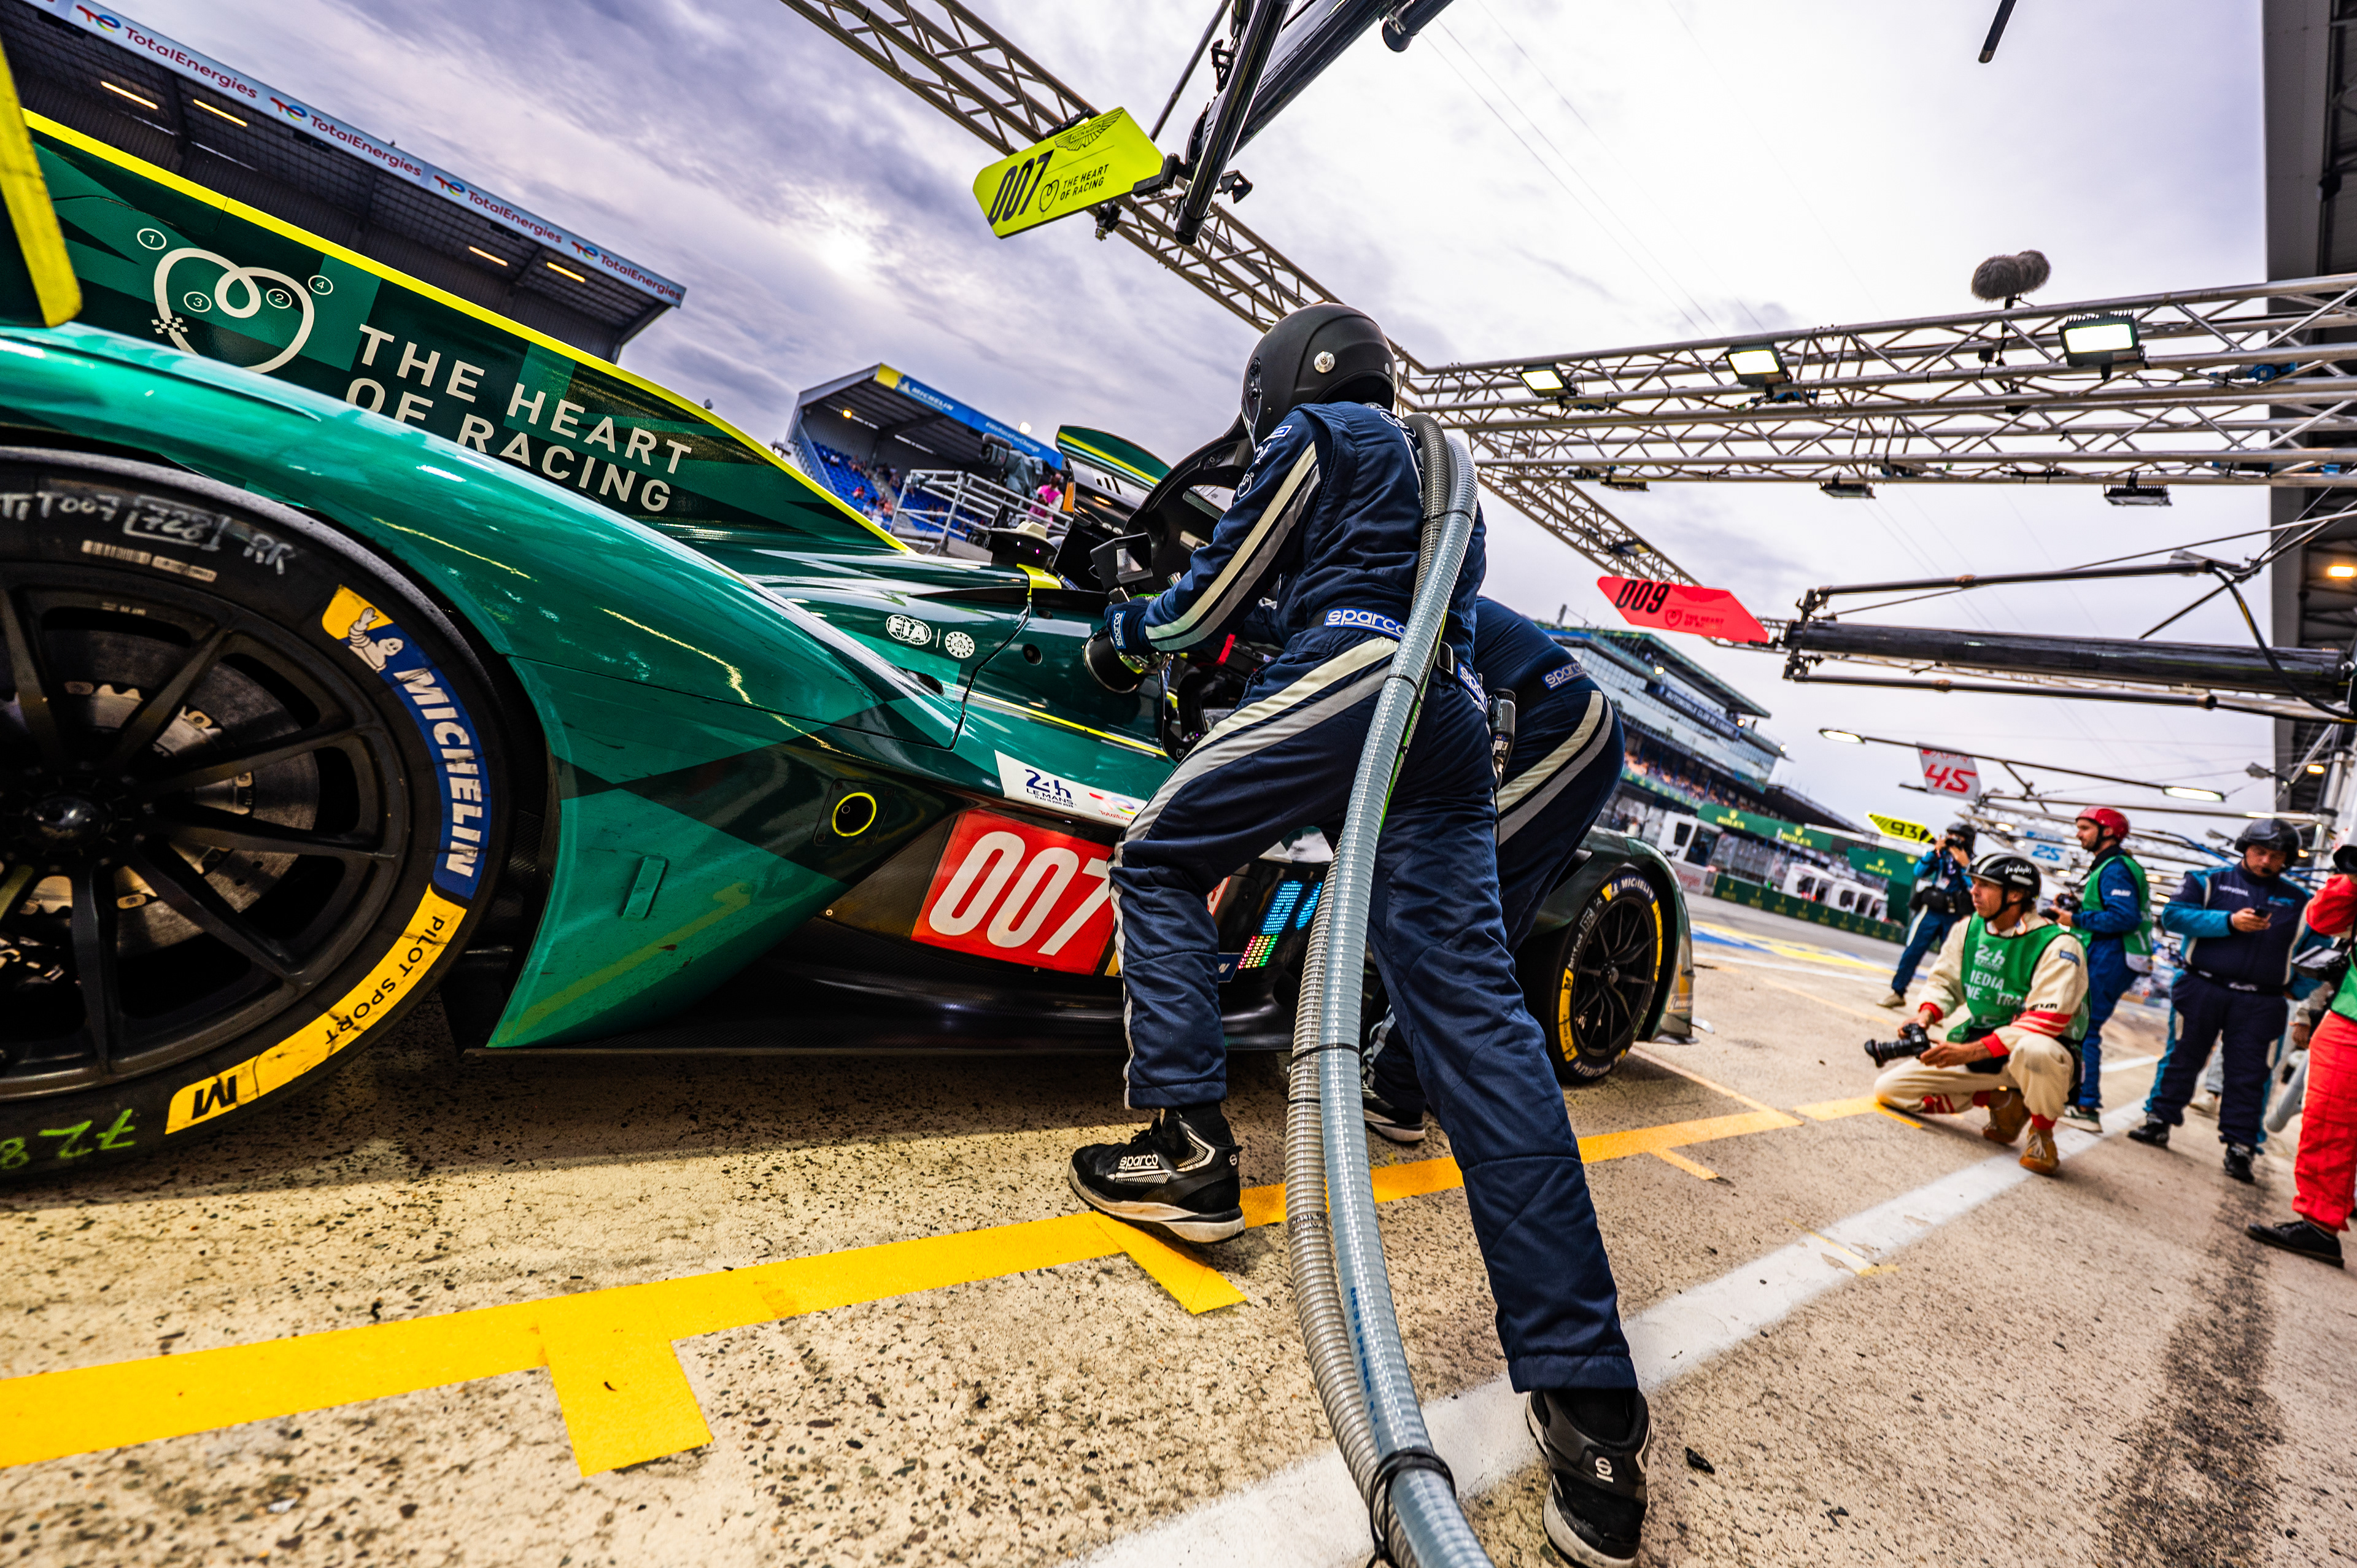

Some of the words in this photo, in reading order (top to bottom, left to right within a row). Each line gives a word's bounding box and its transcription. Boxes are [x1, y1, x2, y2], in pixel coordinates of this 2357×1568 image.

[124, 25, 258, 99] TotalEnergies
[309, 113, 422, 177] TotalEnergies
[1072, 130, 1085, 140] ASTON
[1085, 123, 1102, 134] MARTIN
[987, 149, 1055, 227] 007
[1059, 190, 1071, 201] OF
[1072, 177, 1105, 197] RACING
[1063, 176, 1079, 189] THE
[1080, 163, 1110, 184] HEART
[468, 189, 563, 244] TotalEnergies
[600, 253, 682, 302] TotalEnergies
[358, 323, 486, 404] THE
[506, 382, 692, 475] HEART
[911, 385, 954, 412] MICHELIN
[345, 377, 433, 423] OF
[456, 412, 672, 512] RACING
[1615, 579, 1671, 614] 009
[889, 616, 927, 642] FIA
[1113, 612, 1123, 647] sparco
[1327, 608, 1406, 636] sparco
[393, 668, 484, 878] MICHELIN
[1024, 768, 1072, 800] 24h
[1924, 763, 1978, 795] 45
[1026, 787, 1040, 797] LE
[1042, 792, 1074, 806] MANS
[1716, 815, 1746, 830] ROLEX
[1891, 822, 1918, 840] 93
[1781, 832, 1813, 848] ROLEX
[2031, 843, 2066, 862] 25
[1865, 863, 1893, 876] ROLEX
[928, 830, 1110, 957] 007
[1621, 877, 1654, 899] MICHELIN
[397, 914, 445, 979] PILOT
[325, 977, 397, 1045] SPORT
[1118, 1153, 1159, 1171] sparco
